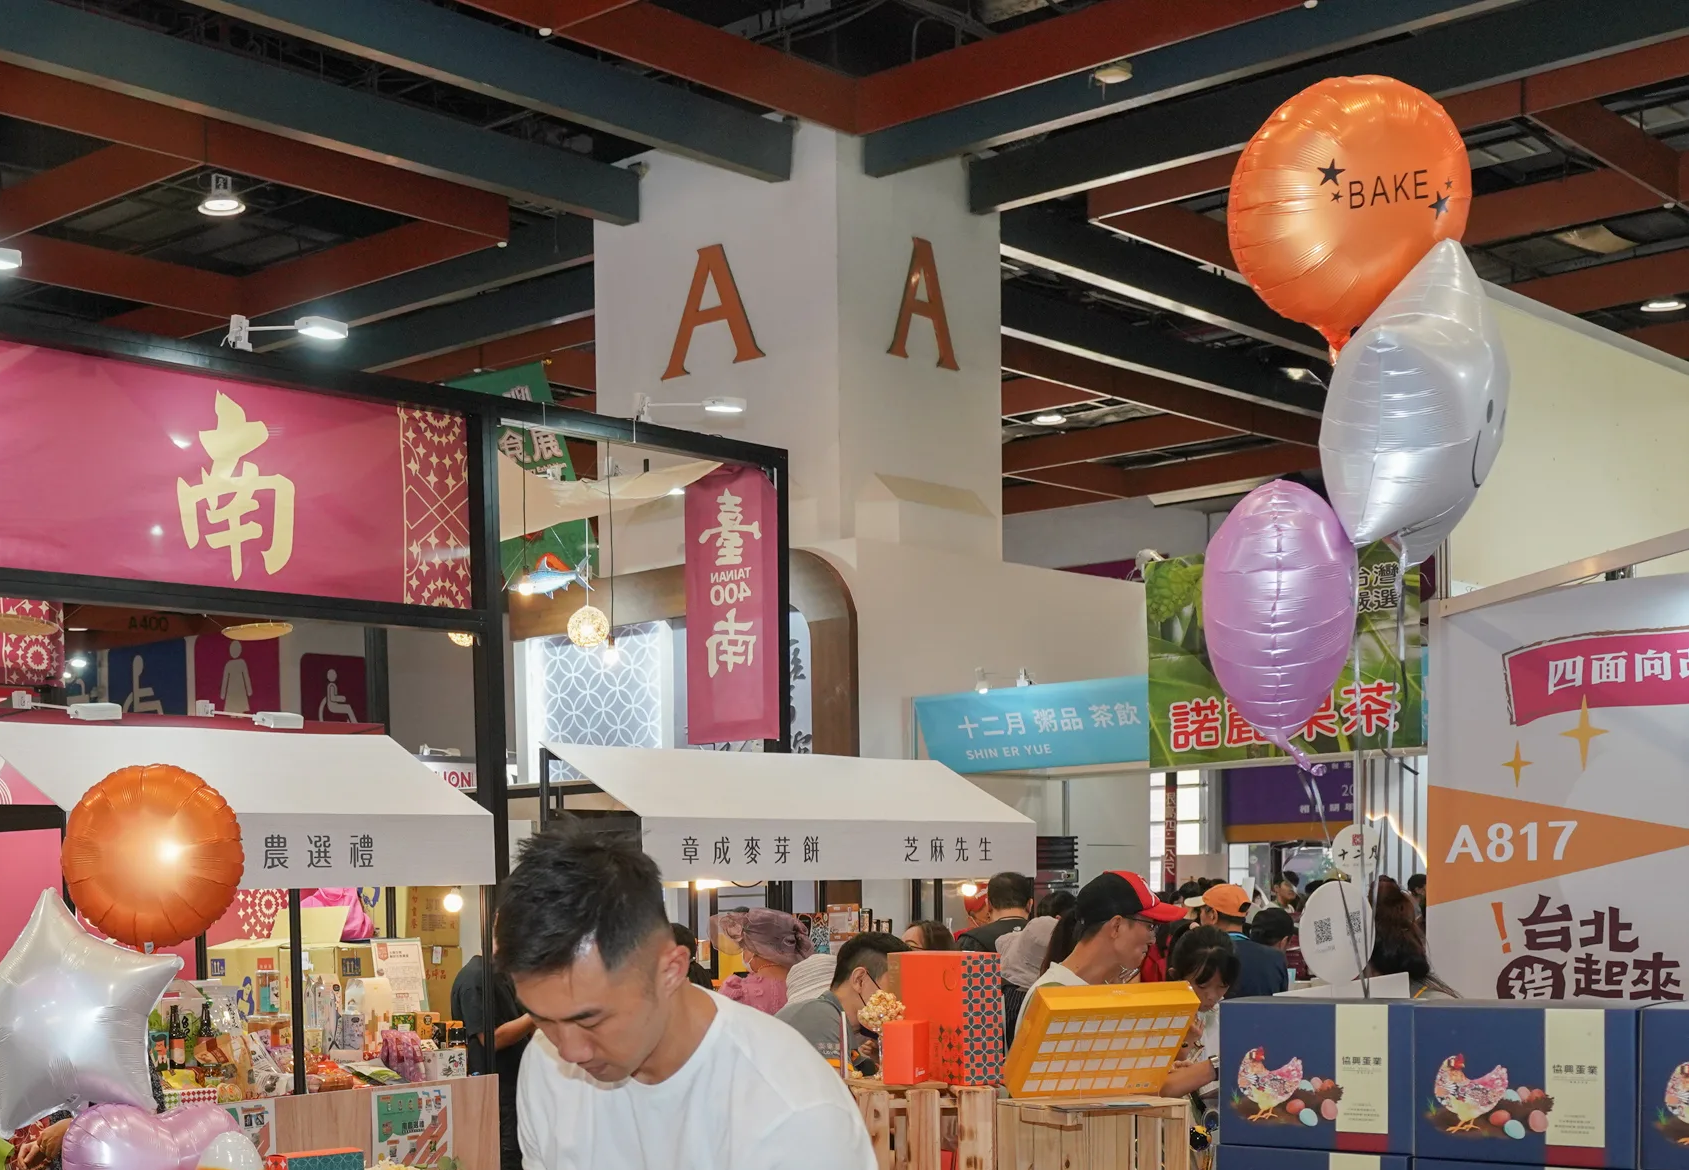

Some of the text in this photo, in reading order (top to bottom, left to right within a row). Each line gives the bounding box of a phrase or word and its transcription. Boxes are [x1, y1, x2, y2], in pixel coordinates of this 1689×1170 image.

[1347, 169, 1430, 211] BAKE
[661, 243, 766, 382] A
[887, 235, 961, 373] A
[957, 700, 1142, 739] 十二月 粥品 茶飲
[965, 744, 1054, 762] SHIN ER YUE
[434, 770, 472, 788] ION
[262, 832, 376, 870] 農選禮
[680, 835, 822, 866] 章成麥芽餅
[903, 835, 994, 864] 芝麻先生
[1444, 819, 1579, 864] A817
[1341, 1055, 1383, 1067] 協興蛋業
[1551, 1063, 1599, 1076] 協興蛋業
